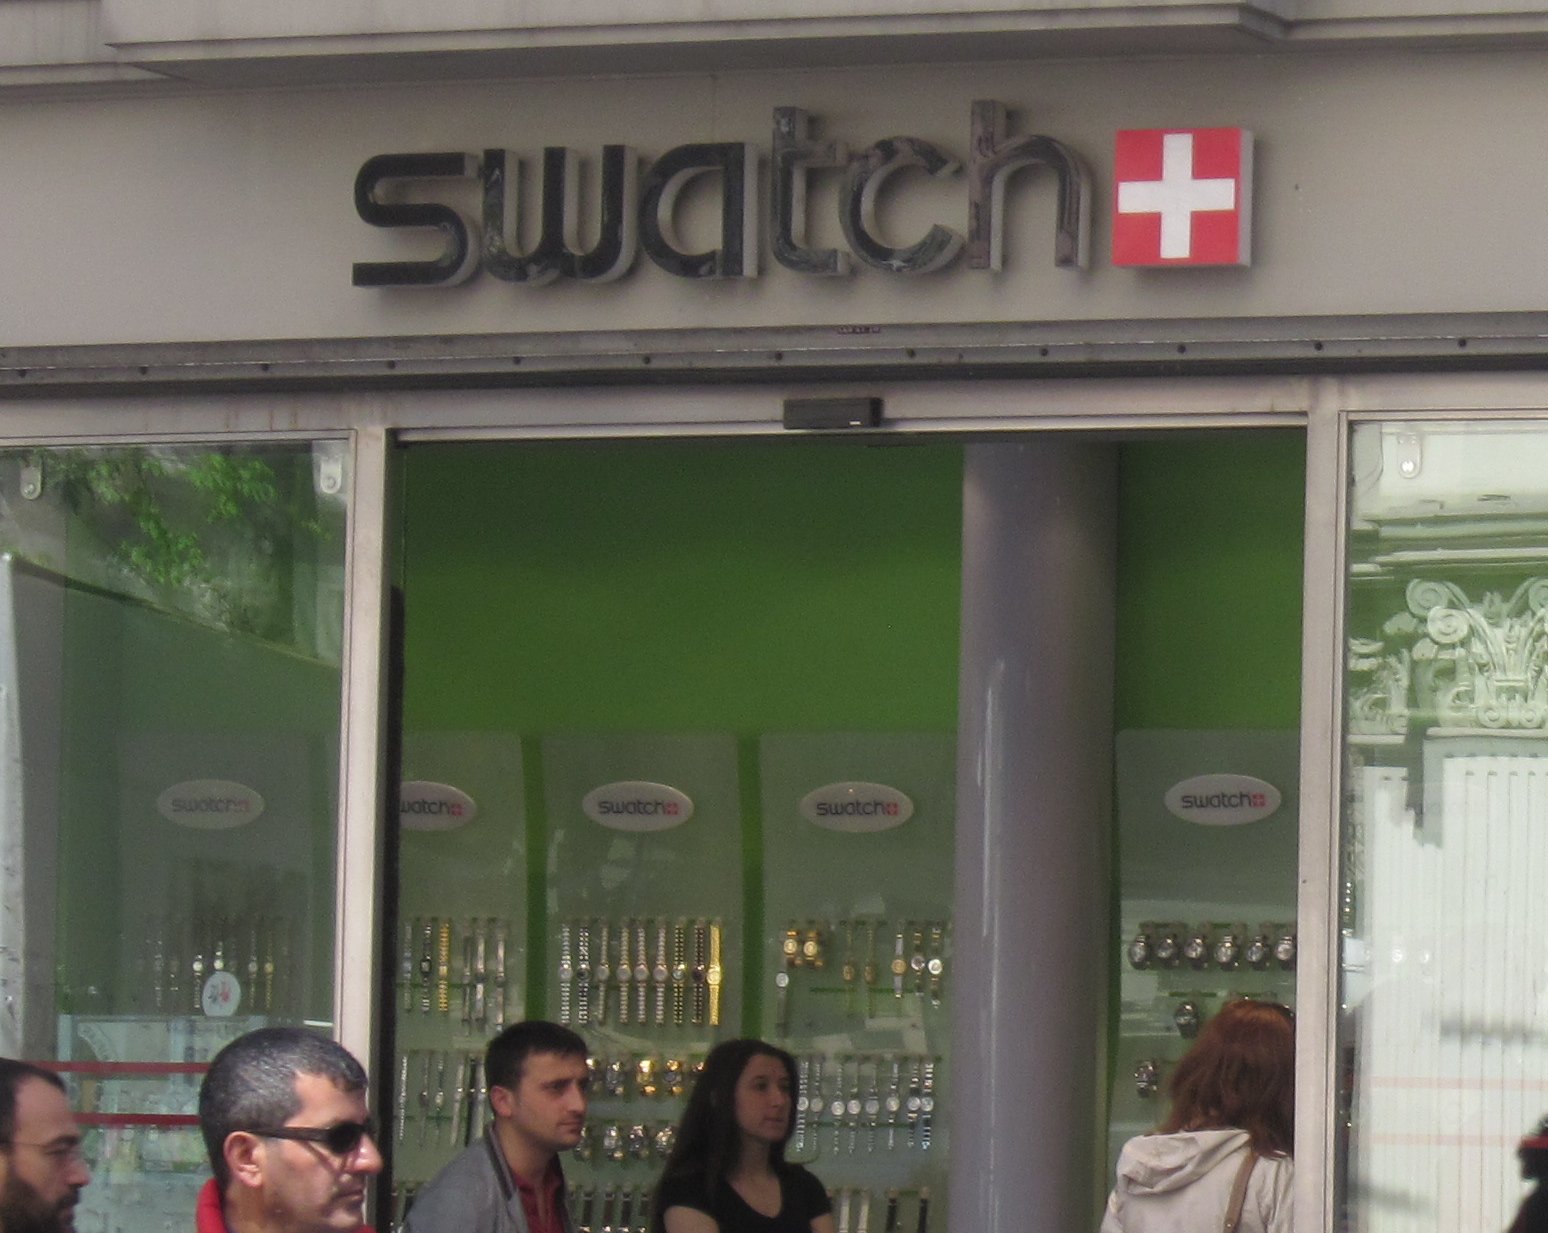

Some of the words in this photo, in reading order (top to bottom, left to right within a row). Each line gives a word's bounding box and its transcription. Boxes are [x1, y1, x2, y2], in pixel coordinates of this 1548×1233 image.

[351, 99, 1092, 288] swatch
[400, 799, 451, 815] watch
[599, 799, 667, 816] swatch
[816, 799, 886, 817] swatch
[1181, 791, 1252, 809] swatch
